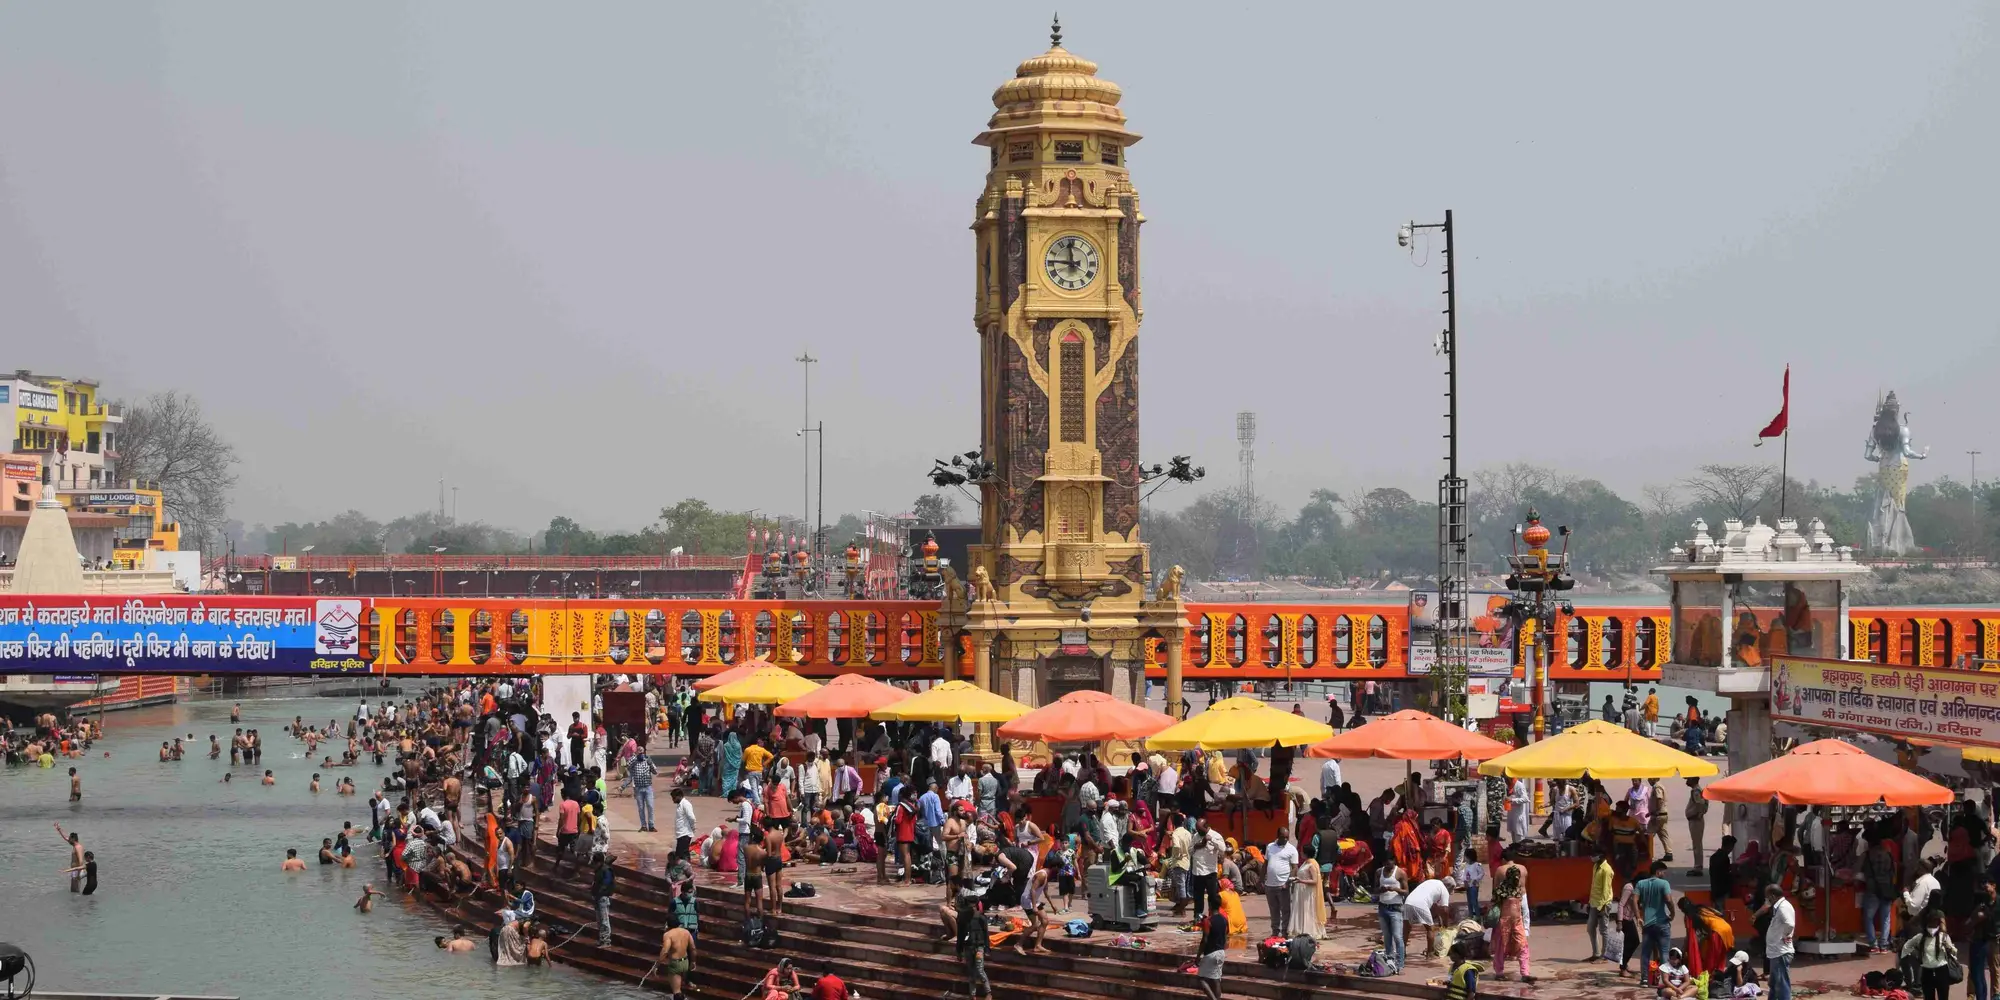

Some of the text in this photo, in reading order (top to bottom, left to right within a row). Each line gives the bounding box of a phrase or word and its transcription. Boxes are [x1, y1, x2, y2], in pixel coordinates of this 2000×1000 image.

[22, 600, 35, 626] से
[37, 600, 91, 628] कतराइये
[122, 599, 189, 626] वैक्सिनेशन
[191, 601, 206, 626] के
[208, 607, 231, 626] बाद
[234, 608, 282, 629] इतराइए
[27, 632, 52, 659] फिर
[54, 632, 70, 658] भी
[122, 632, 144, 667] दूरी
[147, 632, 172, 659] फिर
[173, 632, 190, 658] भी
[192, 640, 217, 659] बना
[219, 633, 234, 659] के
[310, 658, 365, 672] हरिद्वार पुलिस
[1870, 671, 1901, 688] हरकी
[1904, 672, 1925, 694] पैड़ी
[1928, 679, 1976, 695] आगमन
[1980, 683, 1998, 698] पर
[1801, 687, 1836, 704] आपका
[1838, 686, 1874, 708] हार्दिक
[1876, 695, 1916, 714] स्वागत
[1919, 692, 1938, 716] एवं
[1822, 708, 1836, 720] श्री
[1838, 711, 1864, 723] गंगा
[1866, 715, 1892, 727] सभा
[1936, 721, 1983, 736] हरिद्वार
